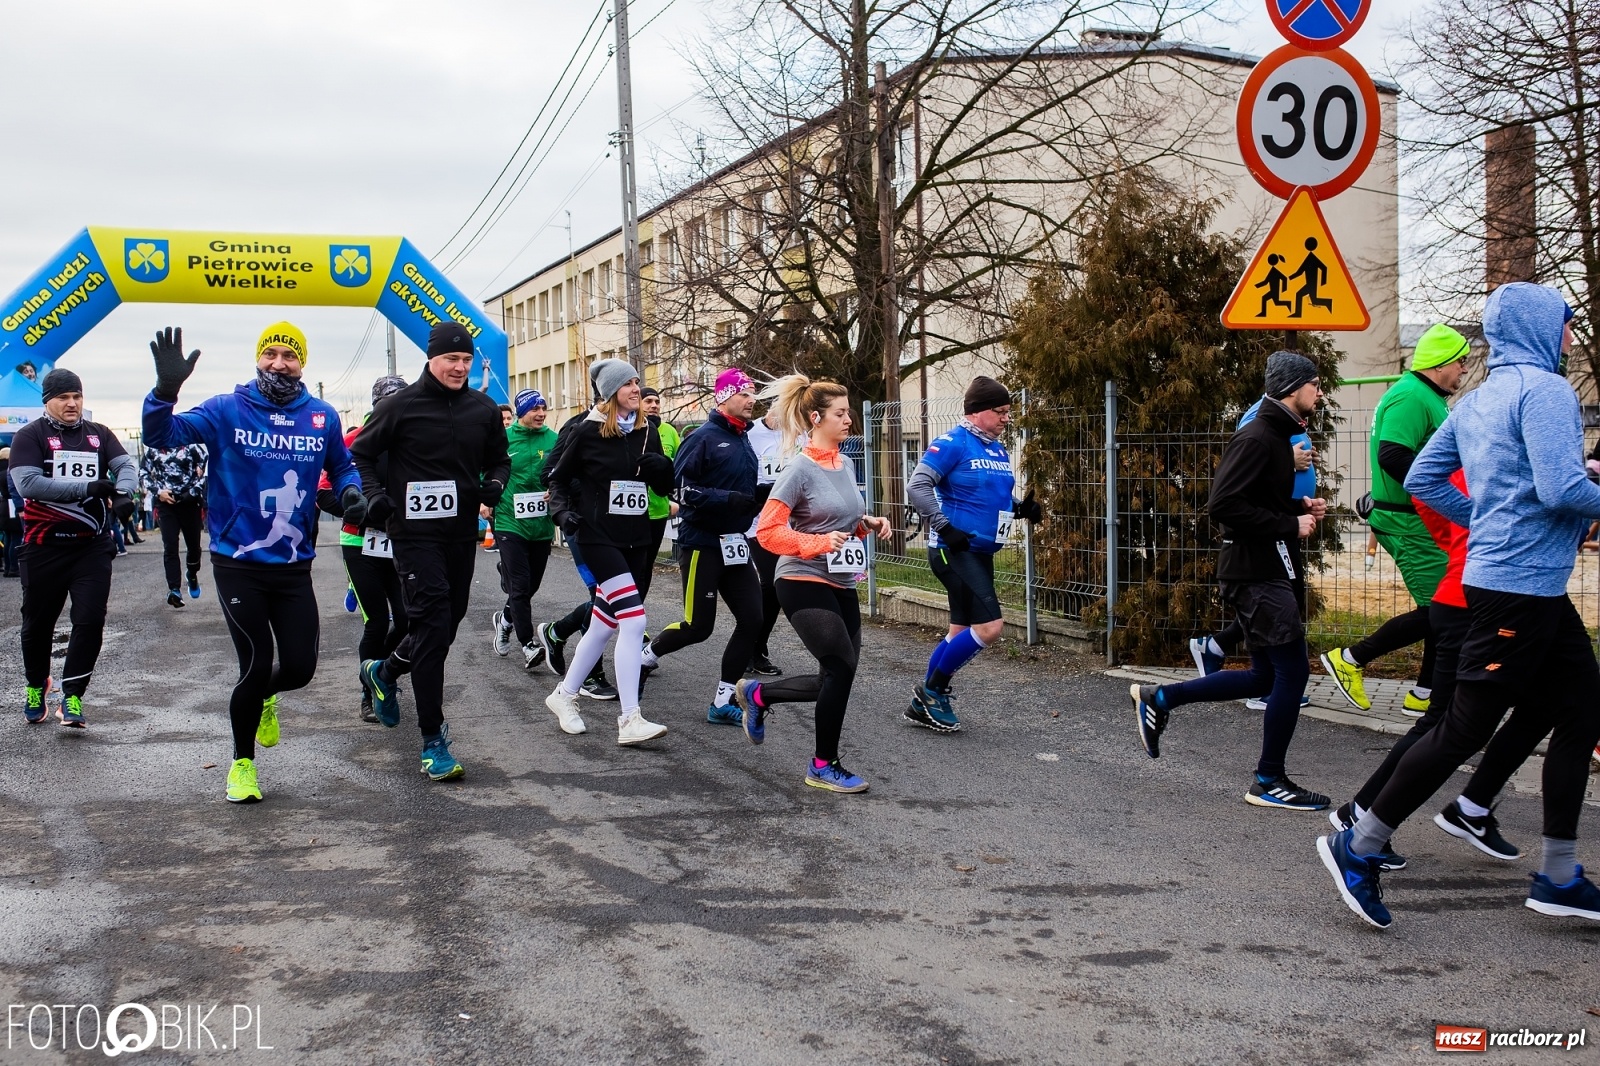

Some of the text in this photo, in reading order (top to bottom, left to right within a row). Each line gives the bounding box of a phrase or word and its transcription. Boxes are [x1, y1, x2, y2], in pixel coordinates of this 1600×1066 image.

[1261, 82, 1358, 161] 30
[209, 240, 291, 254] Gmina
[188, 255, 313, 273] Pietrowice
[204, 274, 297, 289] Wielkie
[2, 252, 91, 332] Gmina ludzi
[403, 263, 483, 338] Gmina ludzi
[23, 271, 106, 346] aktywnych
[234, 428, 325, 452] RUNNERS
[244, 448, 315, 462] EKO-OKNA TEAM
[57, 462, 97, 478] 185
[409, 494, 455, 512] 320
[516, 500, 546, 514] 368
[611, 492, 646, 509] 466
[831, 548, 865, 566] 269
